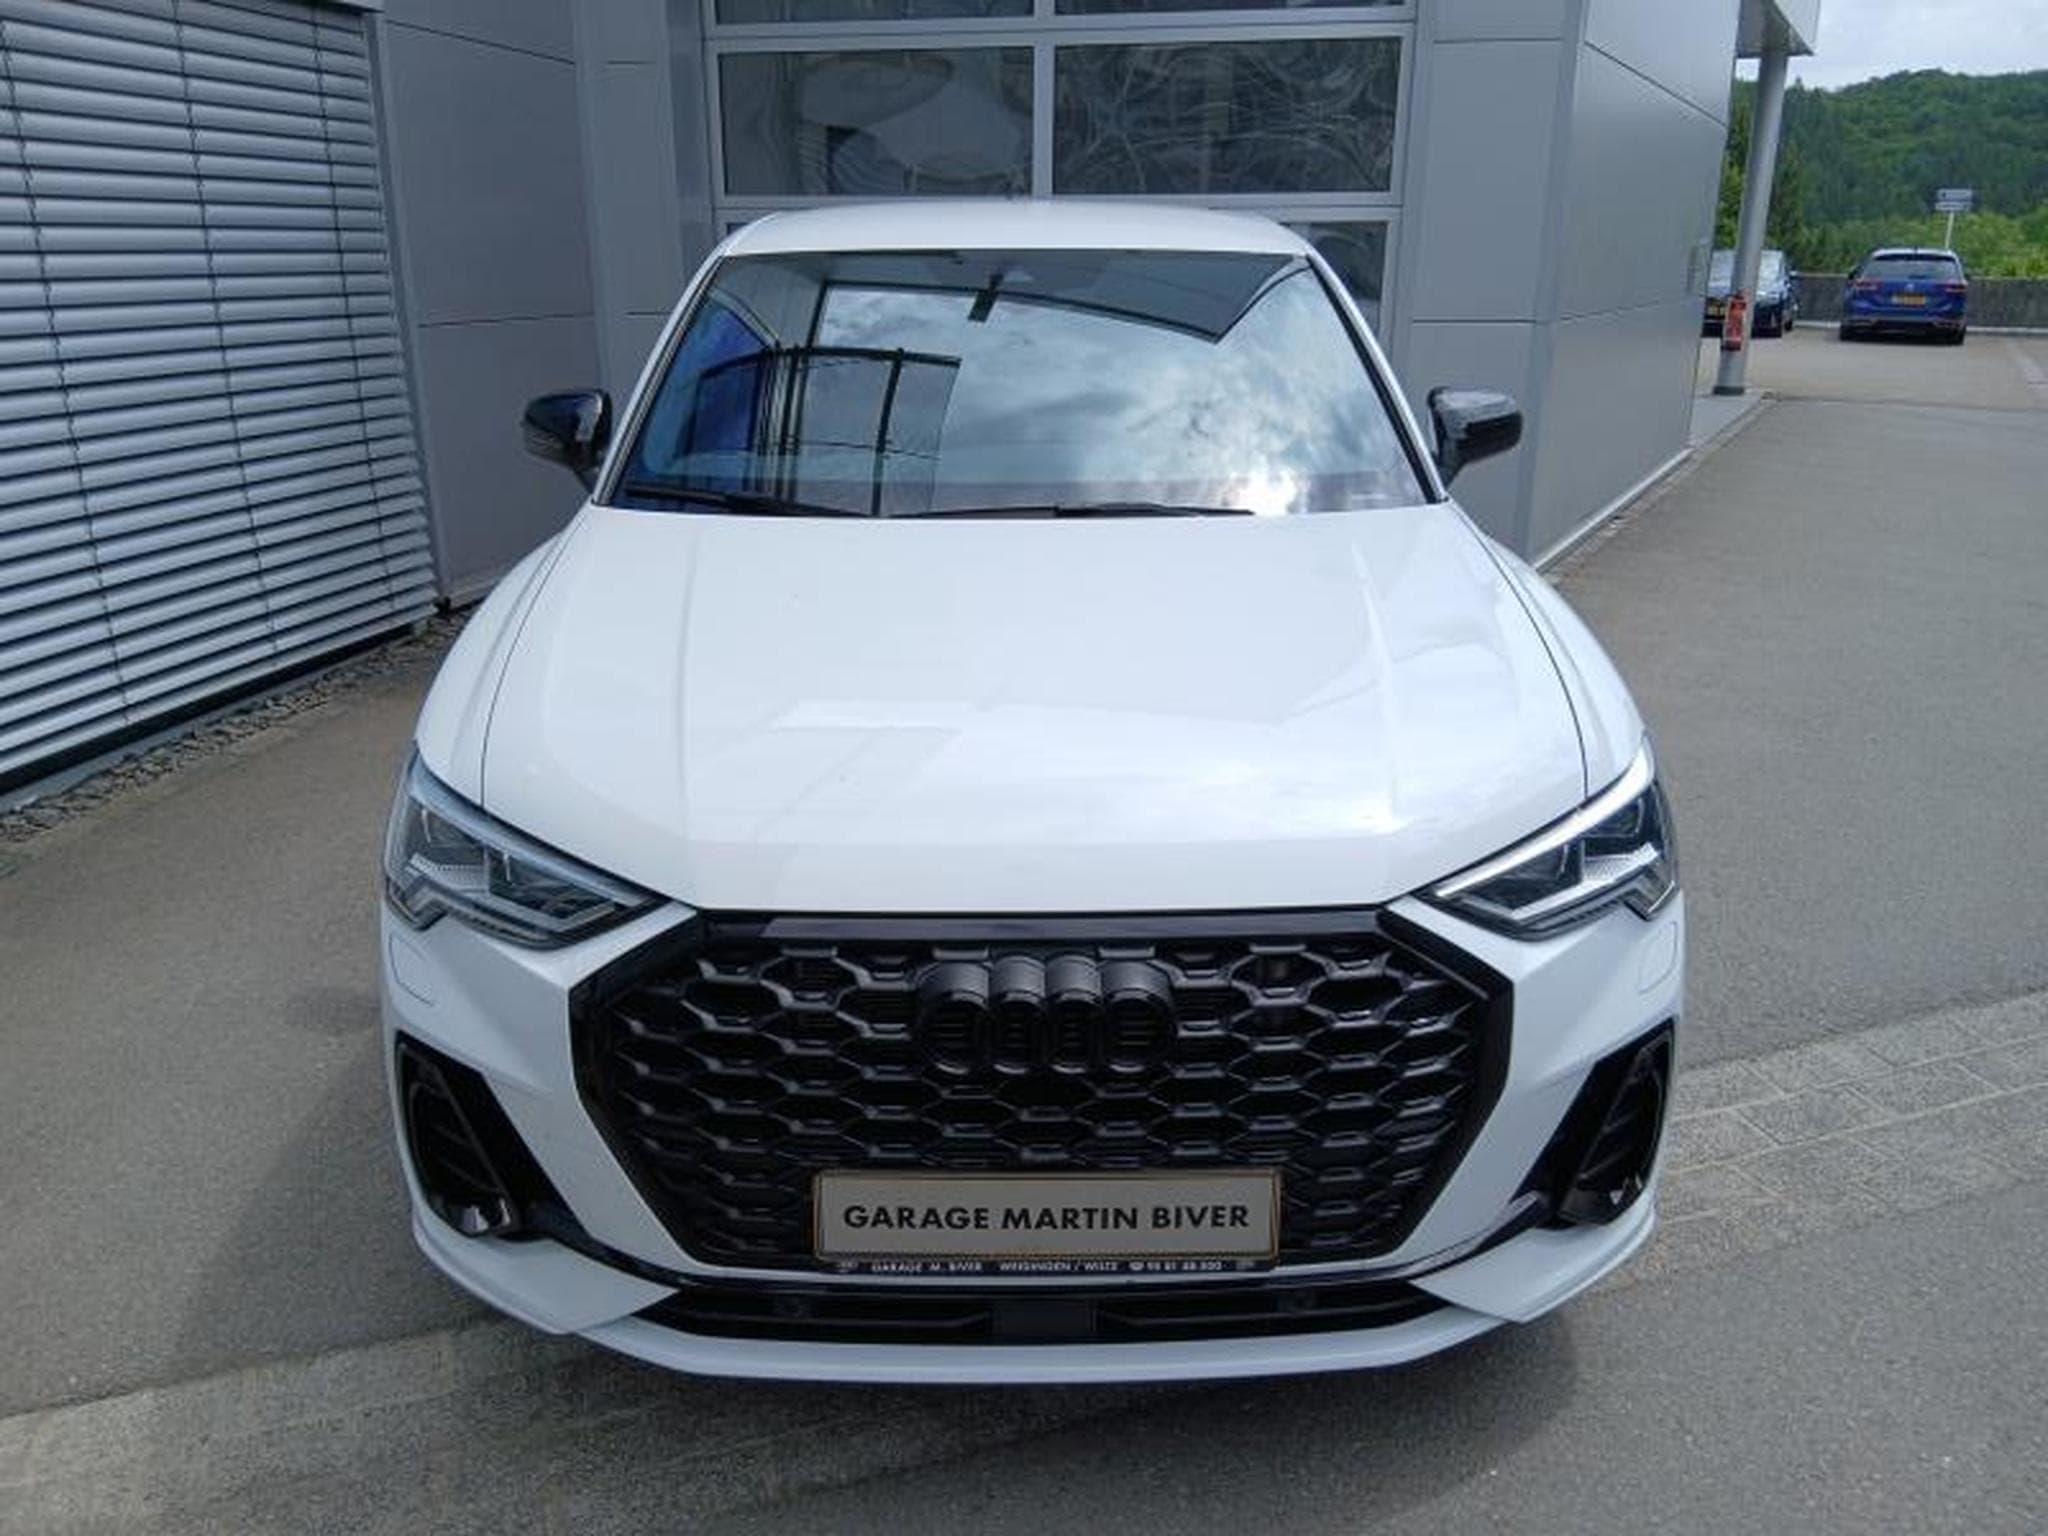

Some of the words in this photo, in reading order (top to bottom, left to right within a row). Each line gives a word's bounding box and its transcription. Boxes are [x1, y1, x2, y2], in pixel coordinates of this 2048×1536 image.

[843, 1205, 989, 1229] GARAGE
[1001, 1207, 1138, 1229] MARTIN
[1152, 1205, 1249, 1228] BIVER
[872, 1261, 922, 1272] GARAGE
